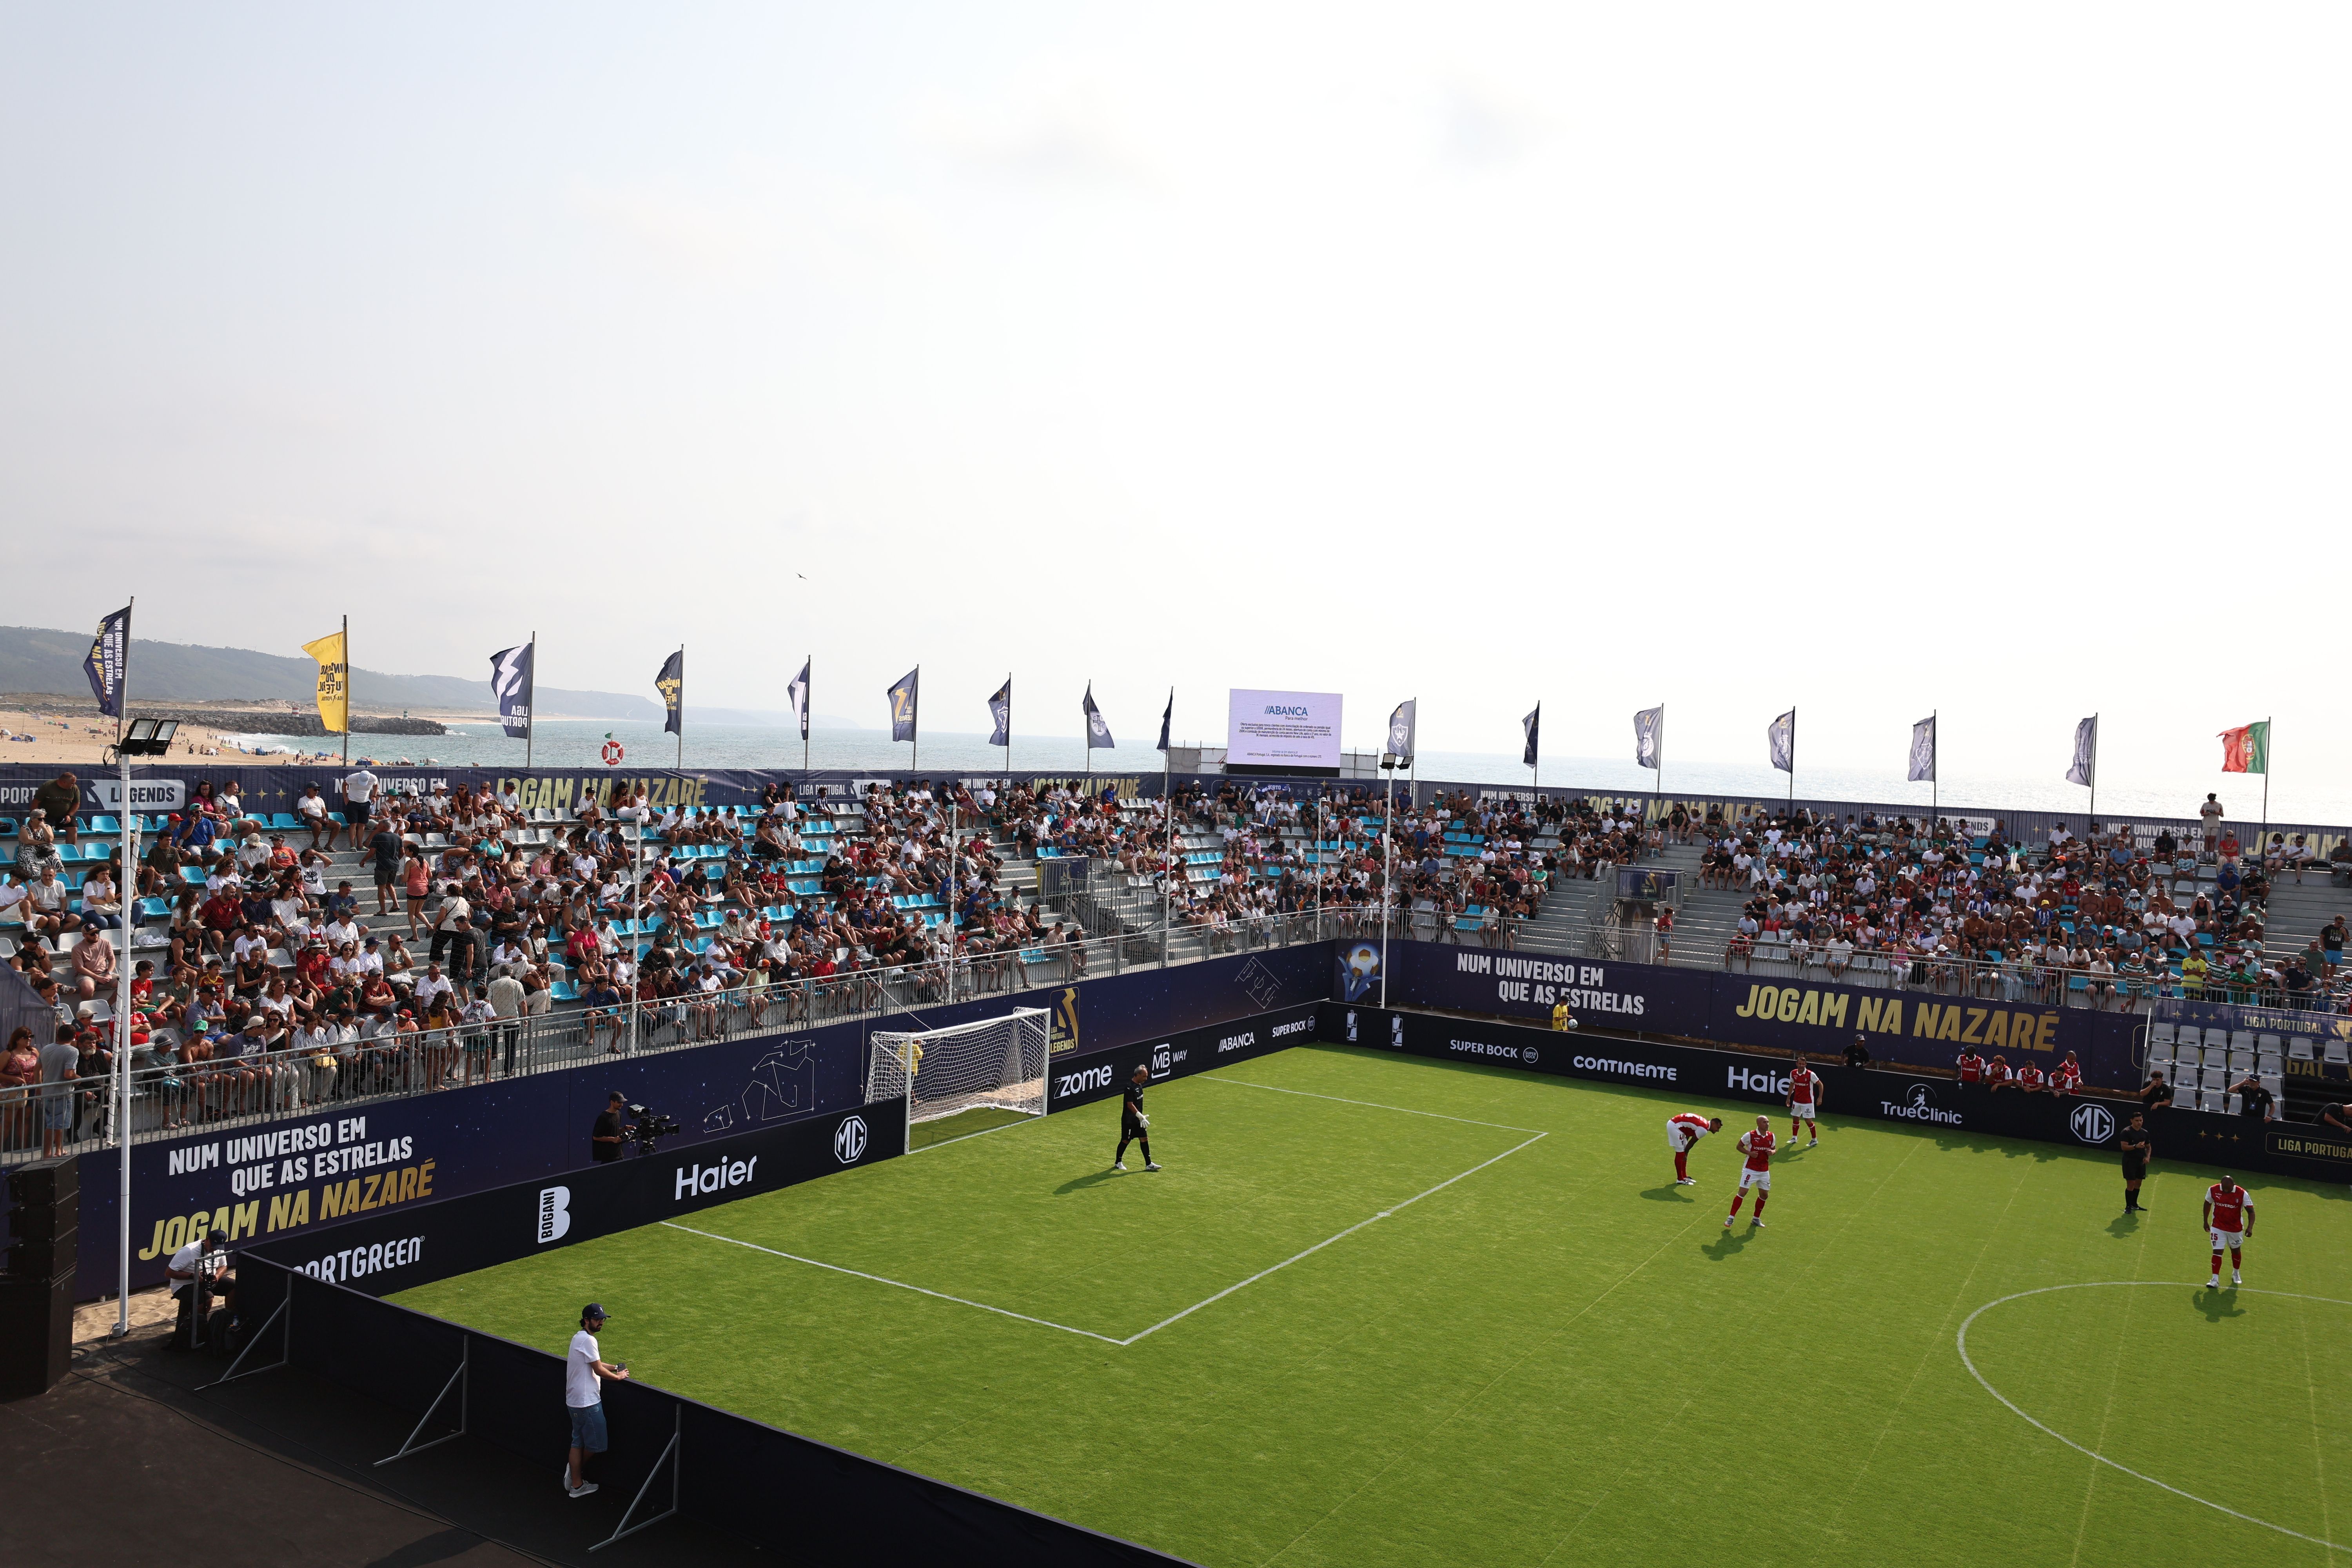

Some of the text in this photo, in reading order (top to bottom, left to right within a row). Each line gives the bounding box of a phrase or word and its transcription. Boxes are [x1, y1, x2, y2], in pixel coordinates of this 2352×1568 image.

[92, 646, 102, 659] NA
[103, 634, 113, 695] QUE AS ESTRELAS
[115, 669, 122, 679] EM
[1, 787, 175, 804] PORT LGENDS
[799, 784, 813, 795] LIGA
[1457, 953, 1604, 987] NUM UNIVERSO EM
[1499, 980, 1530, 1002] QUE
[1534, 984, 1555, 1005] AS
[1272, 1020, 1306, 1037] SUPER BOCK
[1736, 984, 2060, 1052] JOGAM NA NAZARÉ
[2244, 1015, 2323, 1034] LIGA PORTUGAL
[1050, 1032, 1065, 1041] PORTUGAL
[1050, 1038, 1074, 1054] LEGENDS
[1450, 1040, 1518, 1058] SUPER BOCK
[1152, 1049, 1187, 1071] MB WAY
[1728, 1066, 1794, 1096] Haie
[1881, 1102, 1962, 1124] TrueClinic
[2074, 1109, 2111, 1139] MG
[169, 1116, 366, 1176] NUM UNIVERSO EM
[838, 1120, 864, 1158] MG
[2278, 1139, 2352, 1159] LIGA PORTUGA
[232, 1136, 412, 1197] QUE AS ESTRELAS
[675, 1155, 757, 1200] Haier
[139, 1158, 436, 1261] JOGAM NA NAZARÉ
[541, 1191, 555, 1239] BOGANI
[293, 1237, 421, 1283] ORTGREEN
